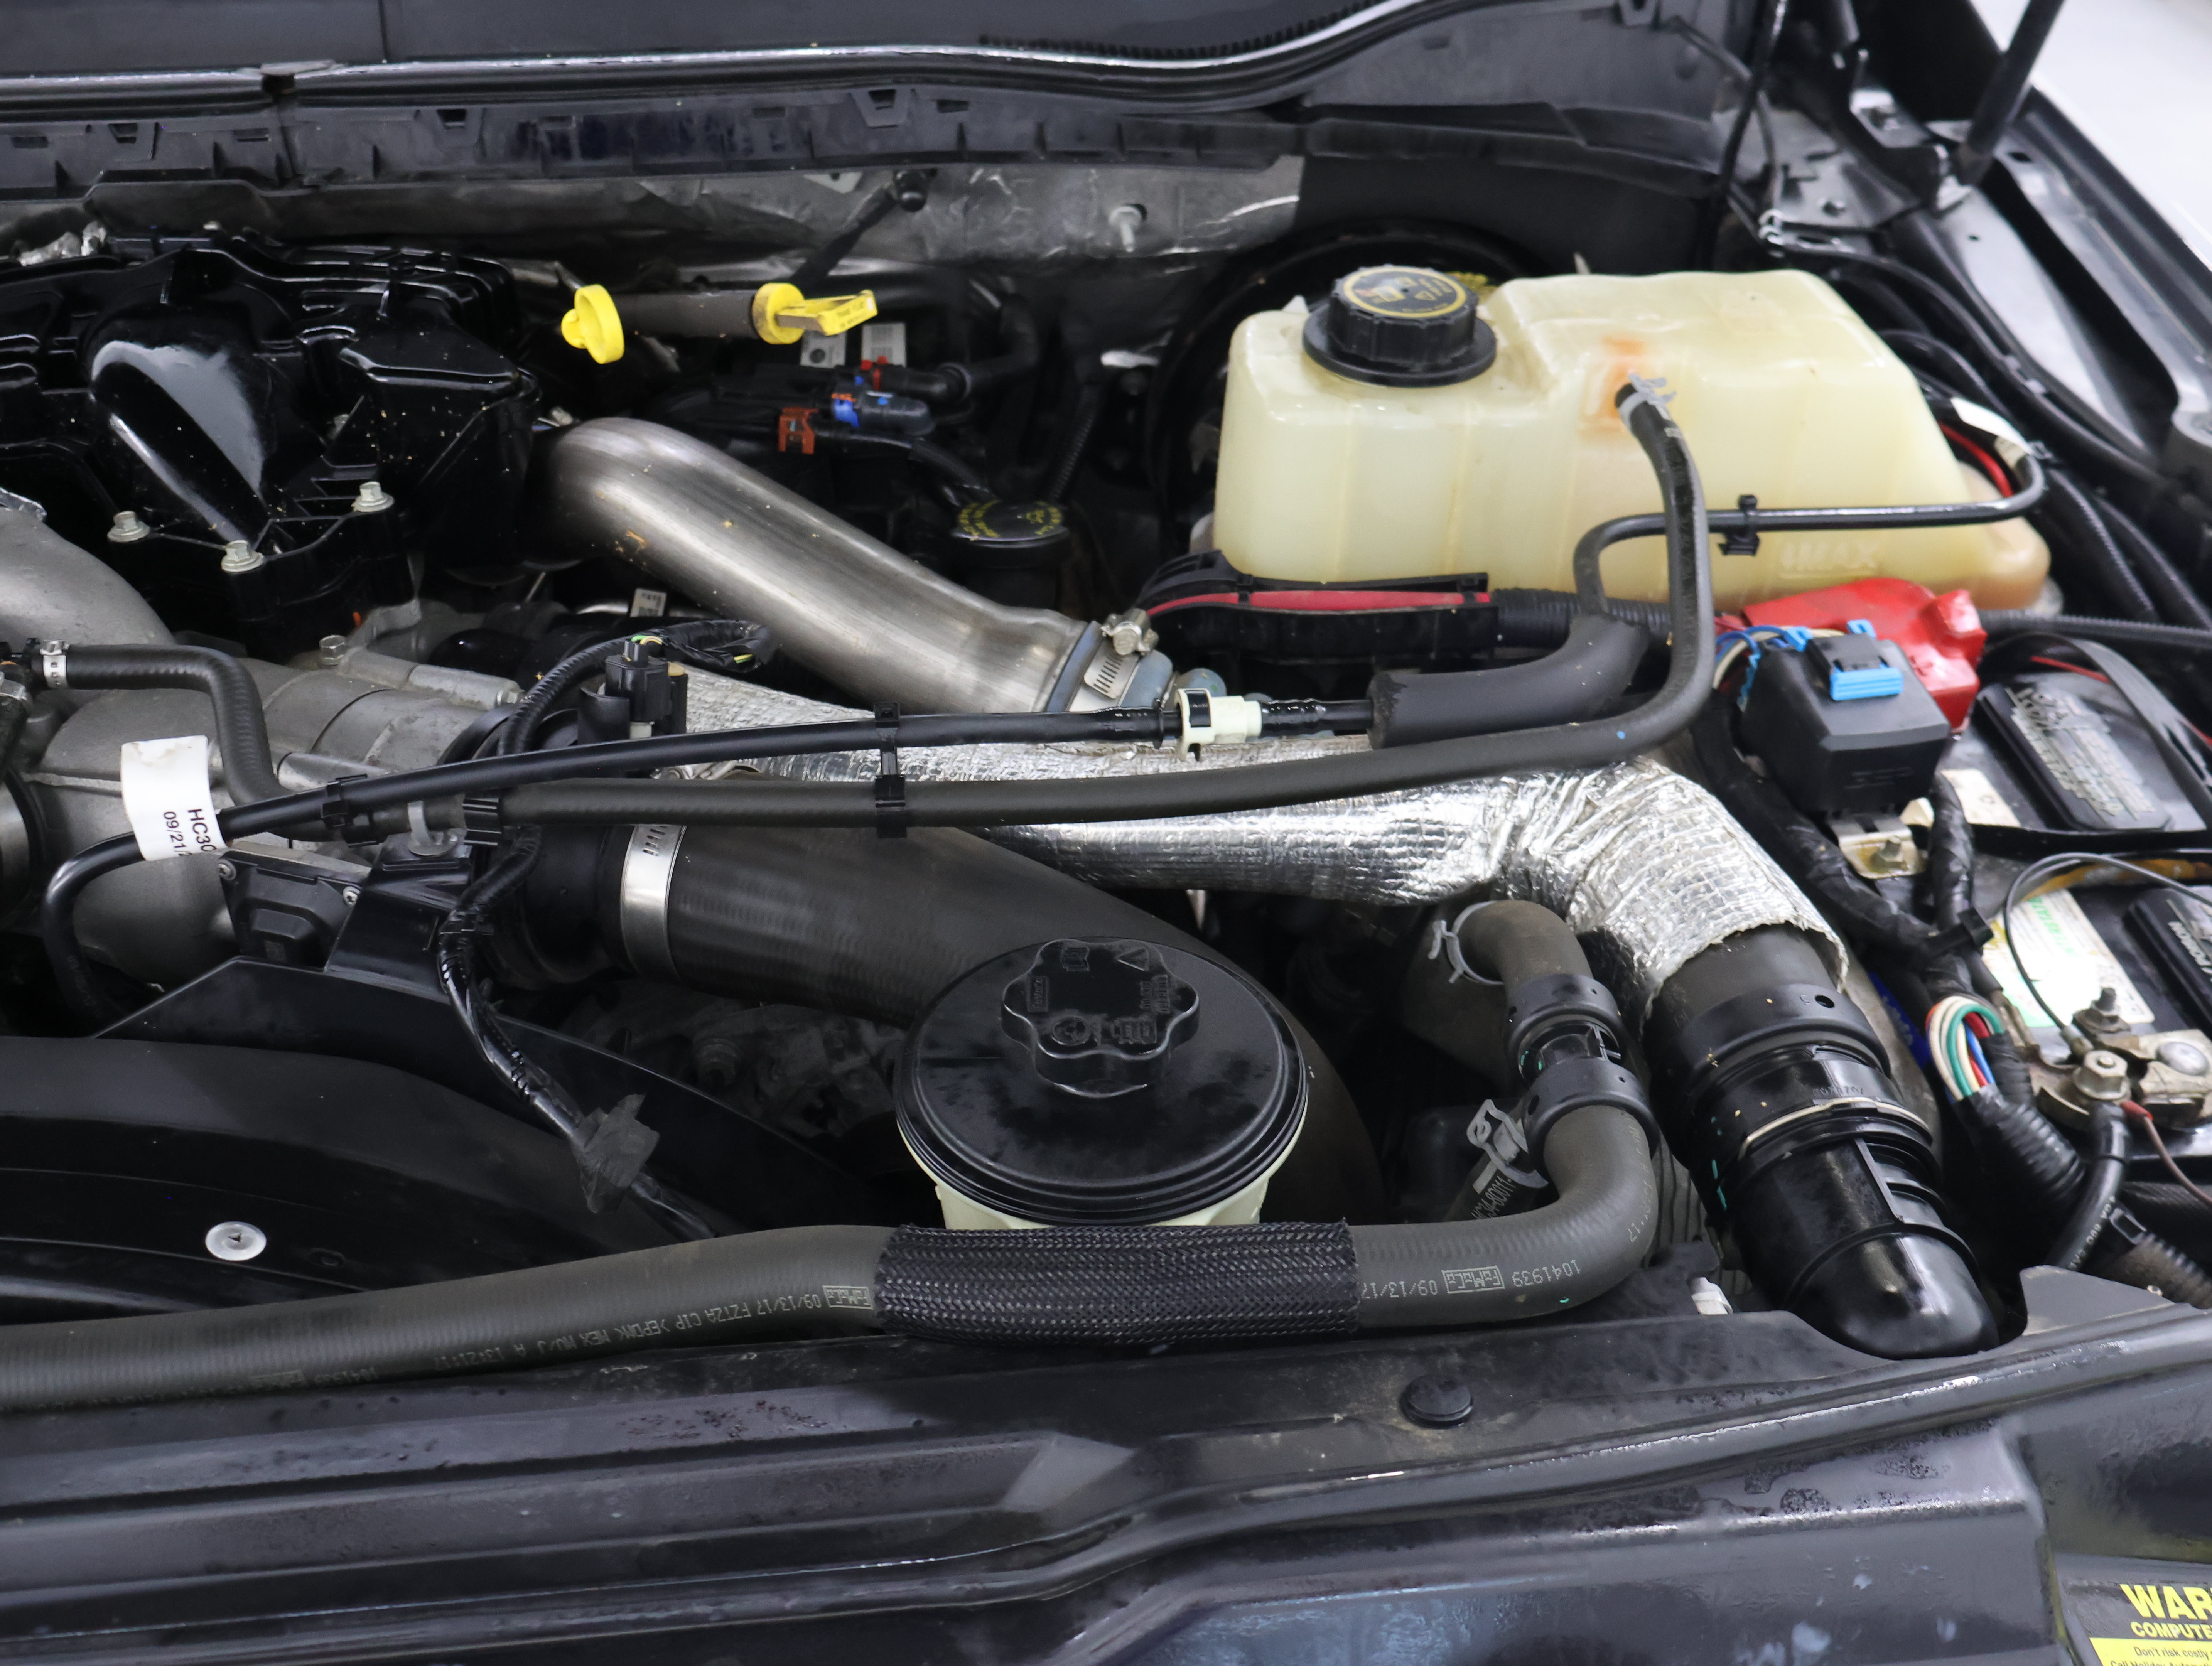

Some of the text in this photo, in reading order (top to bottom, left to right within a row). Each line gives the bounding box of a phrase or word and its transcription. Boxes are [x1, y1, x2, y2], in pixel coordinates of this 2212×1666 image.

[1511, 1259, 1582, 1287] 1041939
[1360, 1280, 1438, 1298] 09/13/17
[756, 1292, 822, 1315] 09/13/17
[2119, 1584, 2212, 1620] WAR
[2133, 1646, 2161, 1657] Don't
[2162, 1647, 2182, 1658] risk
[2182, 1649, 2210, 1661] costly
